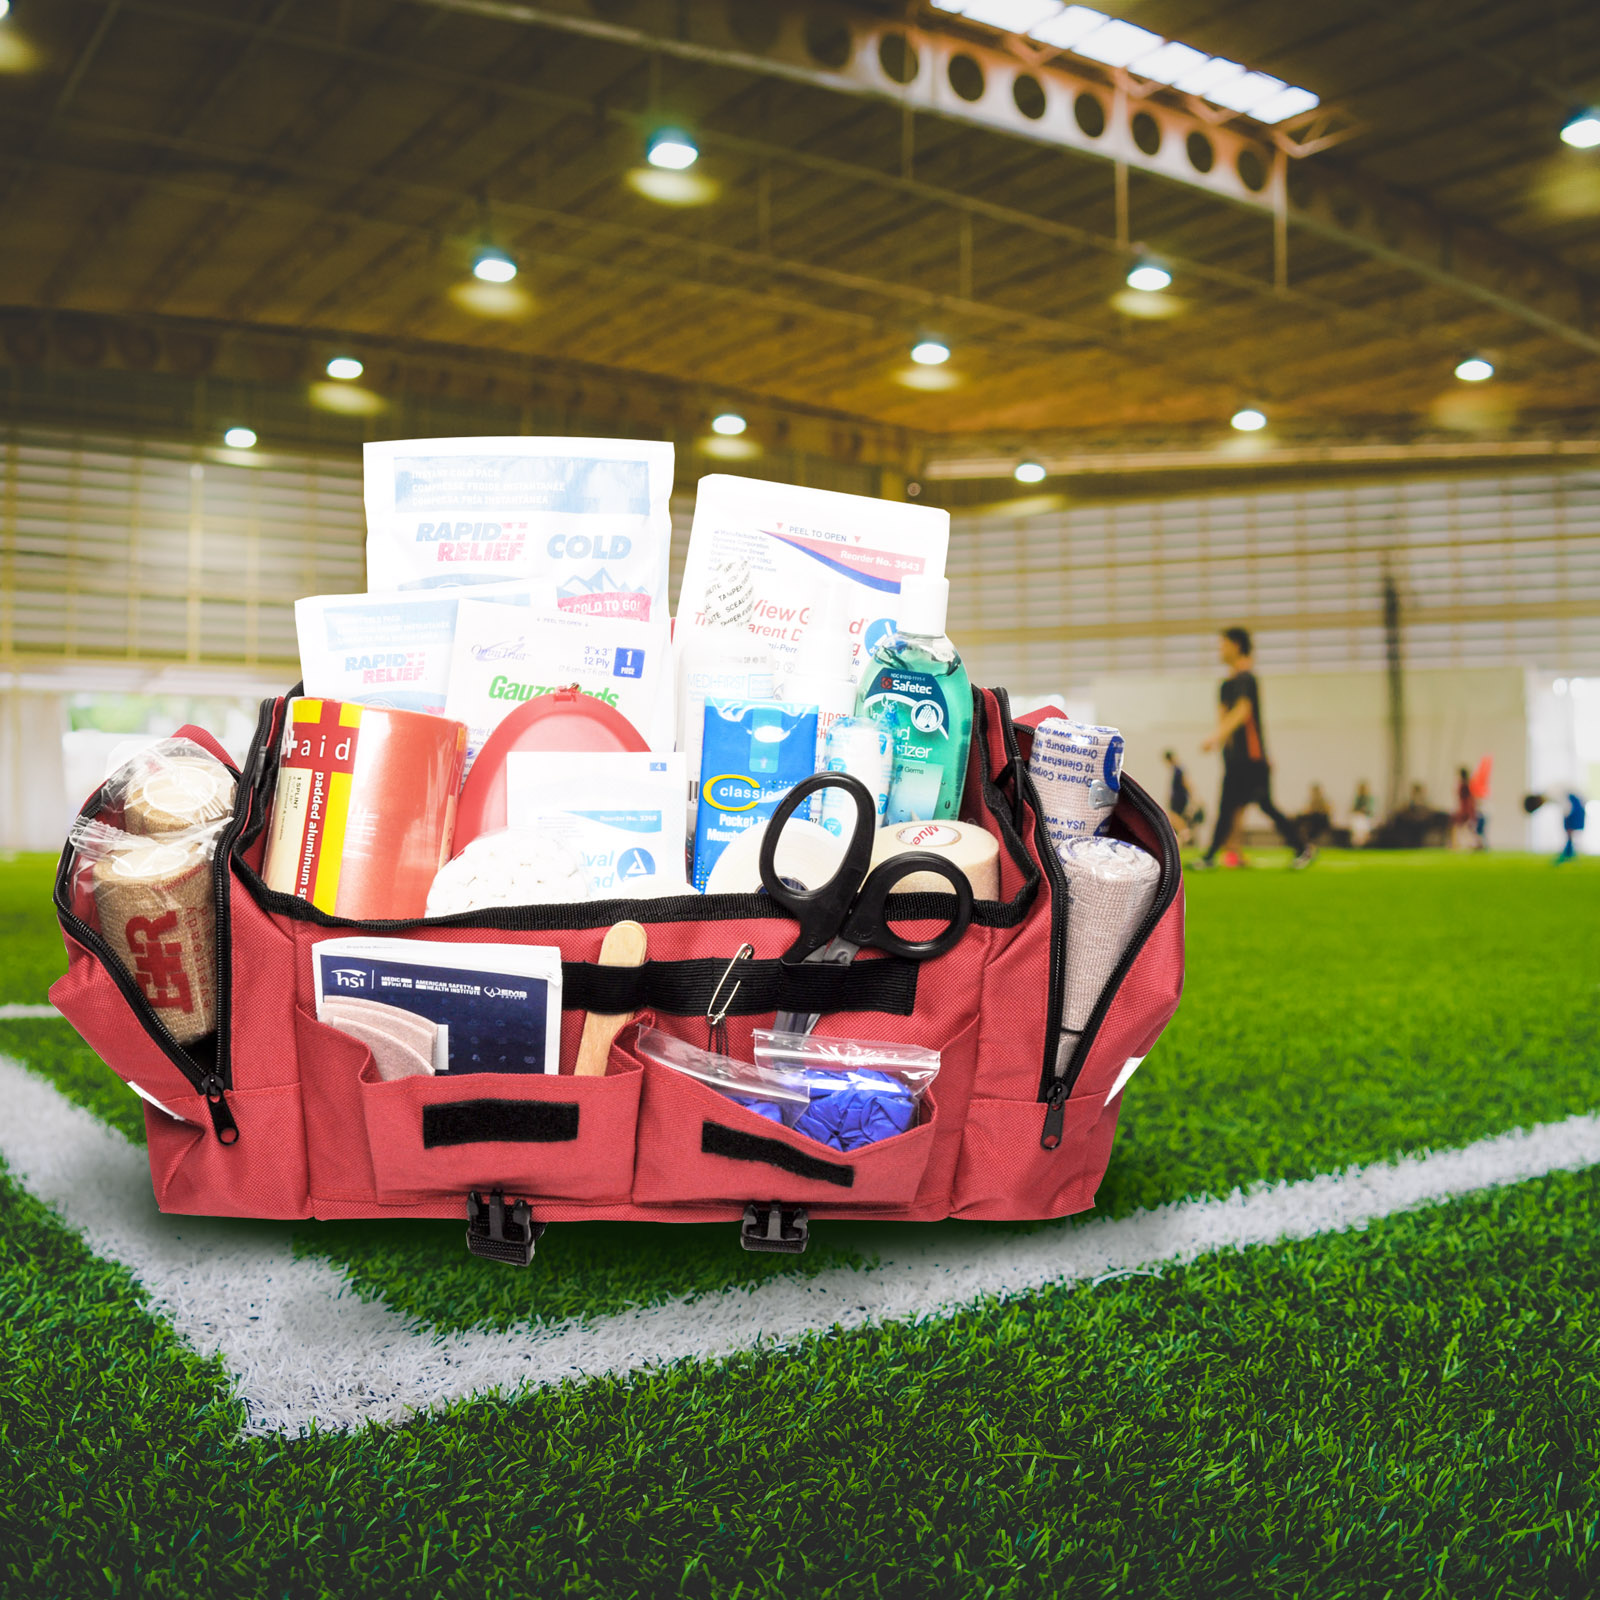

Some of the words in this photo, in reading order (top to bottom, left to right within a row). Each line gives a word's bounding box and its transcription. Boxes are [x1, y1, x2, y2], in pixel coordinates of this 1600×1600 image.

[415, 522, 503, 542] RAPID
[789, 526, 810, 537] PEEL
[811, 529, 823, 538] TO
[824, 532, 848, 543] OPEN
[436, 541, 525, 561] RELIEF
[547, 534, 633, 560] COLD
[840, 550, 875, 564] Reorder
[875, 556, 892, 567] No.
[894, 559, 921, 573] 3643
[604, 599, 620, 612] TO
[344, 652, 406, 672] RAPID
[584, 656, 594, 666] 12
[595, 658, 611, 669] Ply
[626, 650, 633, 666] 1
[362, 667, 424, 685] RELIEF
[892, 679, 933, 695] Safetec
[577, 685, 619, 709] ads
[300, 734, 352, 761] aid
[904, 766, 924, 775] Germs
[1041, 754, 1083, 772] Glenshaw
[1084, 763, 1095, 773] 10
[1056, 773, 1093, 788] Dynarex
[294, 782, 302, 810] SPLINT
[310, 771, 324, 820] padded
[719, 785, 775, 799] classic
[719, 813, 754, 828] Pocket
[1066, 819, 1087, 830] USA
[706, 828, 742, 843] Mouch
[300, 822, 317, 886] aluminum
[580, 849, 615, 868] val
[591, 871, 615, 889] ad
[334, 970, 365, 989] hsi
[415, 979, 448, 988] AMERICAN
[426, 984, 450, 993] HEALTH
[450, 986, 481, 996] INSTITUTE
[501, 989, 528, 997] EMS
